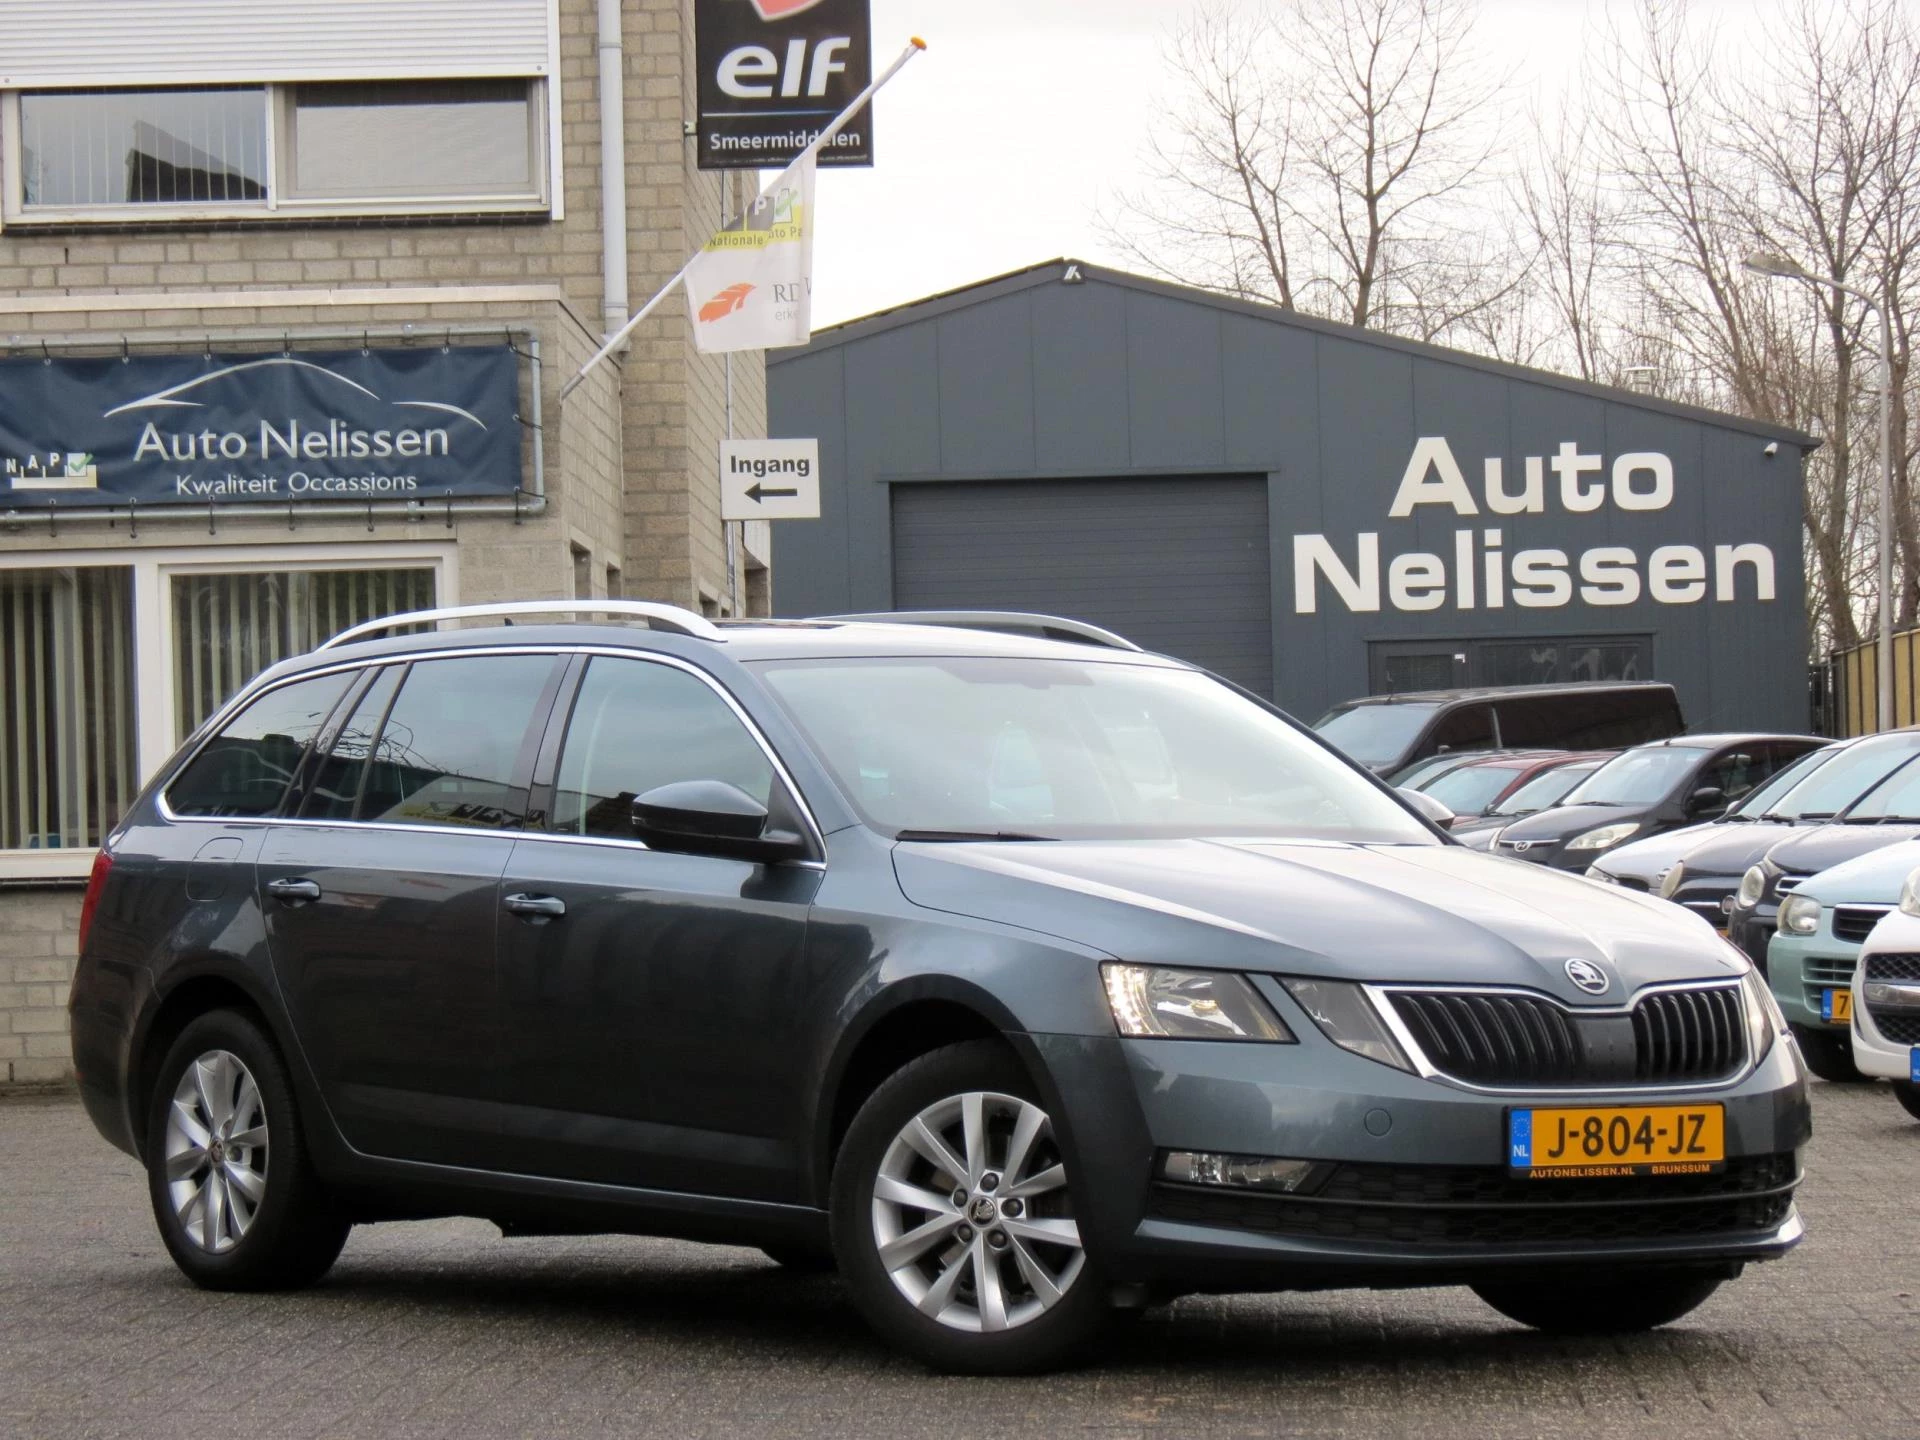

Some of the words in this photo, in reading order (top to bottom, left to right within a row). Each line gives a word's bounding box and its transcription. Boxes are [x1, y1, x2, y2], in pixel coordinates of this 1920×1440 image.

[716, 36, 851, 99] elf
[710, 130, 861, 150] Smeermiddlen
[133, 421, 248, 462] Auto
[260, 418, 449, 460] Nelissen
[176, 474, 278, 496] Kwaliteit
[288, 471, 418, 493] Occassions
[730, 455, 810, 478] Ingang
[1387, 435, 1674, 518] Auto
[1292, 528, 1776, 614] Nelissen
[1512, 1144, 1530, 1158] NL
[1547, 1113, 1706, 1159] J-804-JZ
[1529, 1166, 1637, 1179] AUTONELISSEN.NL
[1651, 1163, 1711, 1176] BRUNSSUM
